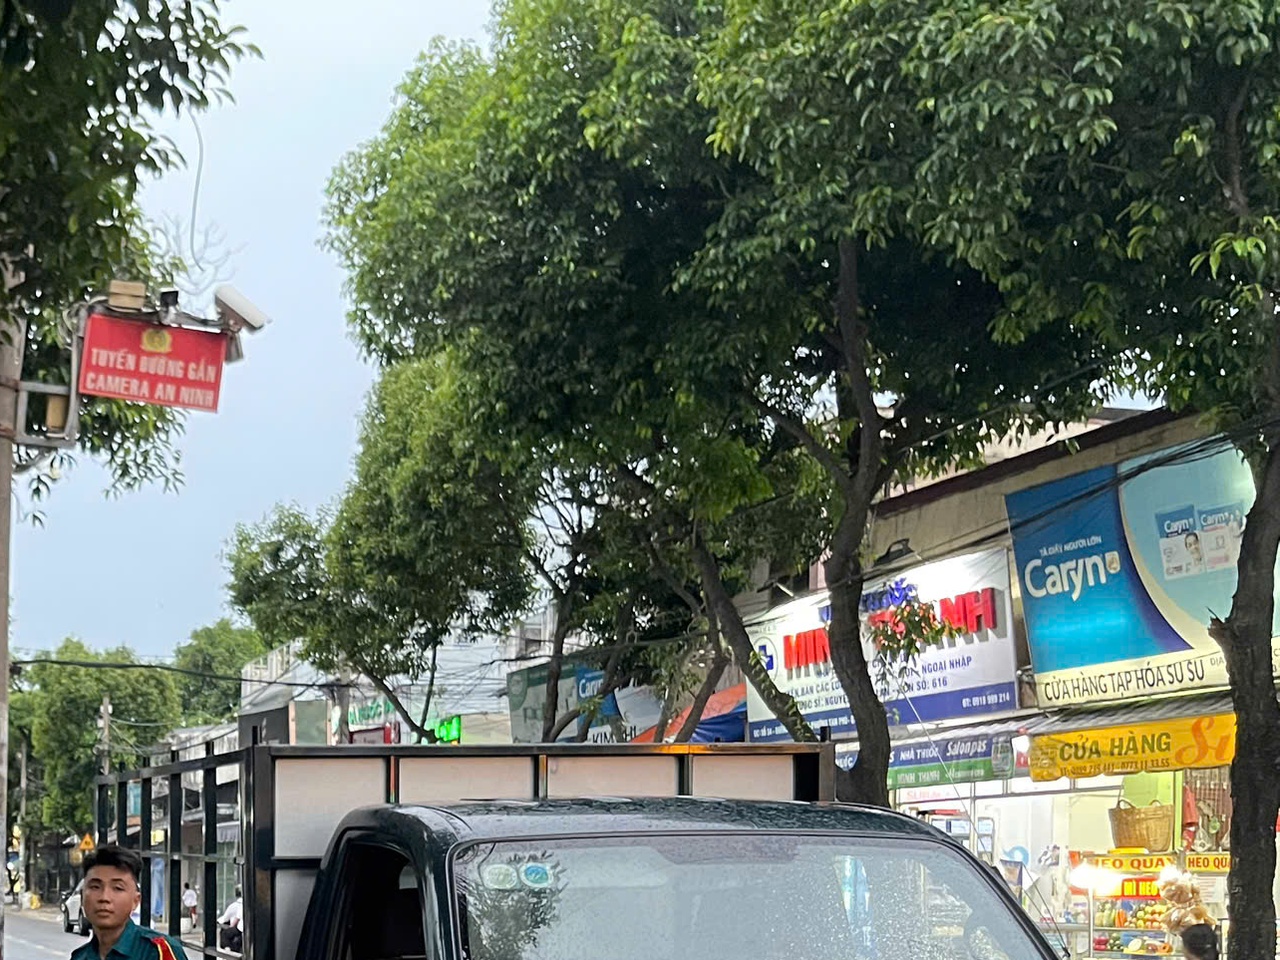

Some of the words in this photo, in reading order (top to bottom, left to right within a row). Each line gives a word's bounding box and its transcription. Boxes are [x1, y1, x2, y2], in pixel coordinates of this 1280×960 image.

[91, 347, 137, 372] TUYẾN
[139, 354, 185, 379] ĐƯỜNG
[85, 372, 150, 398] CAMERA
[153, 382, 176, 401] AN
[179, 386, 215, 407] NINH
[1024, 555, 1107, 602] Caryn
[948, 656, 973, 670] NHẬP
[1072, 671, 1107, 698] HÀNG
[1110, 672, 1132, 698] TẠP
[1135, 662, 1166, 690] HÓA
[1166, 664, 1184, 685] SU
[1188, 660, 1205, 682] SU
[900, 748, 915, 761] NHÀ
[946, 740, 987, 757] Salonpas
[1059, 734, 1101, 761] CỬA
[1109, 730, 1172, 757] HÀNG
[1188, 857, 1210, 868] HEO
